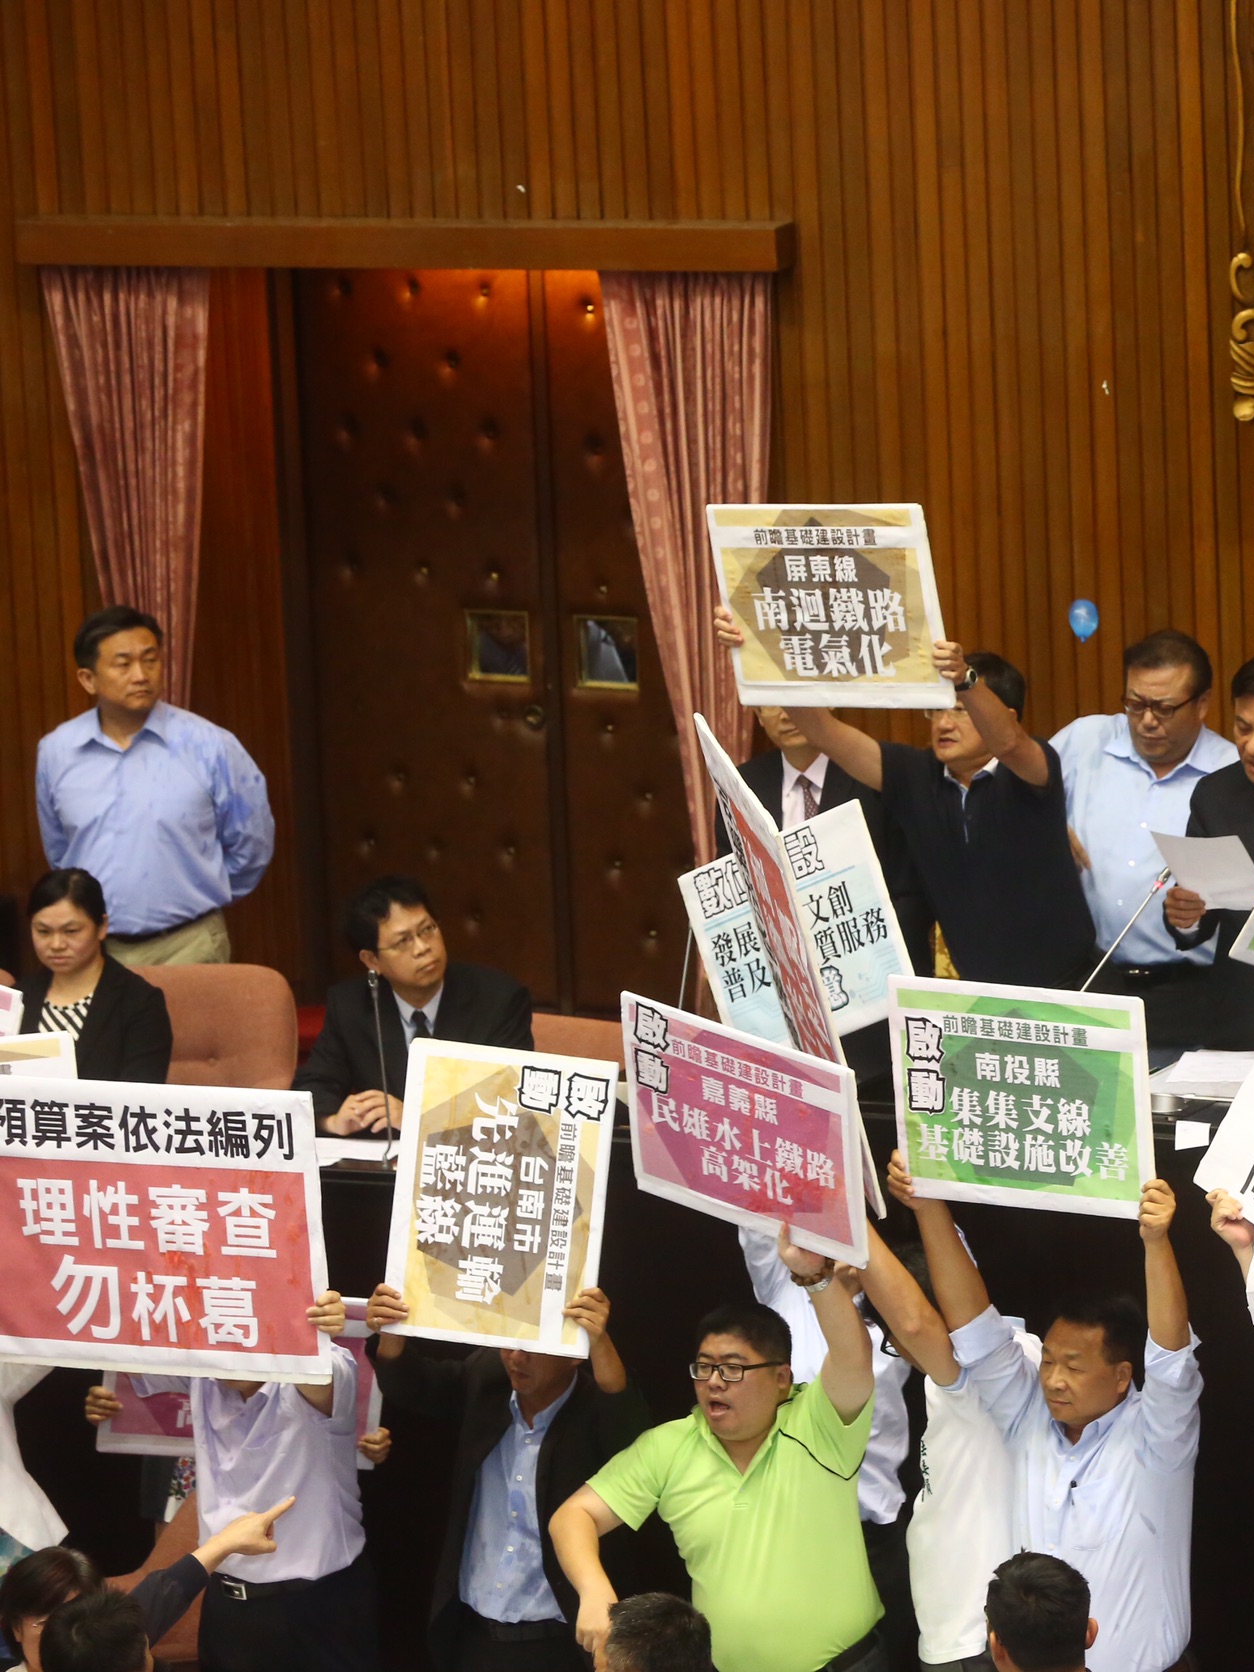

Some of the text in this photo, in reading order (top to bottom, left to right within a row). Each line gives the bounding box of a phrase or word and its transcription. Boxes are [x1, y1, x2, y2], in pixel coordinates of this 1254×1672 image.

[753, 528, 877, 546] 前瞻基礎建設計畫
[784, 555, 858, 582] 屏東線
[751, 587, 908, 633] 南迴鐵路
[779, 633, 896, 679] 電氣化
[801, 881, 854, 929] 文創
[634, 1001, 670, 1095] 啟動
[942, 1014, 1089, 1047] 前瞻基礎建設計畫
[671, 1038, 804, 1099] 前瞻基礎建設計畫
[904, 1015, 946, 1115] 啟動
[974, 1052, 1061, 1088] 南投縣
[700, 1075, 779, 1126] 嘉義縣
[949, 1086, 1092, 1138] 集集支線
[650, 1092, 836, 1190] 民雄水上鐵路
[917, 1123, 1130, 1182] 基礎設施改善
[414, 1141, 467, 1245] 藍線
[454, 1091, 520, 1306] 先進運輸
[512, 1155, 549, 1254] 台南市
[700, 1144, 794, 1206] 高架化
[16, 1177, 278, 1259] 理性審查
[543, 1122, 579, 1292] 前瞻基礎建設計畫
[50, 1253, 260, 1348] 勿杯葛
